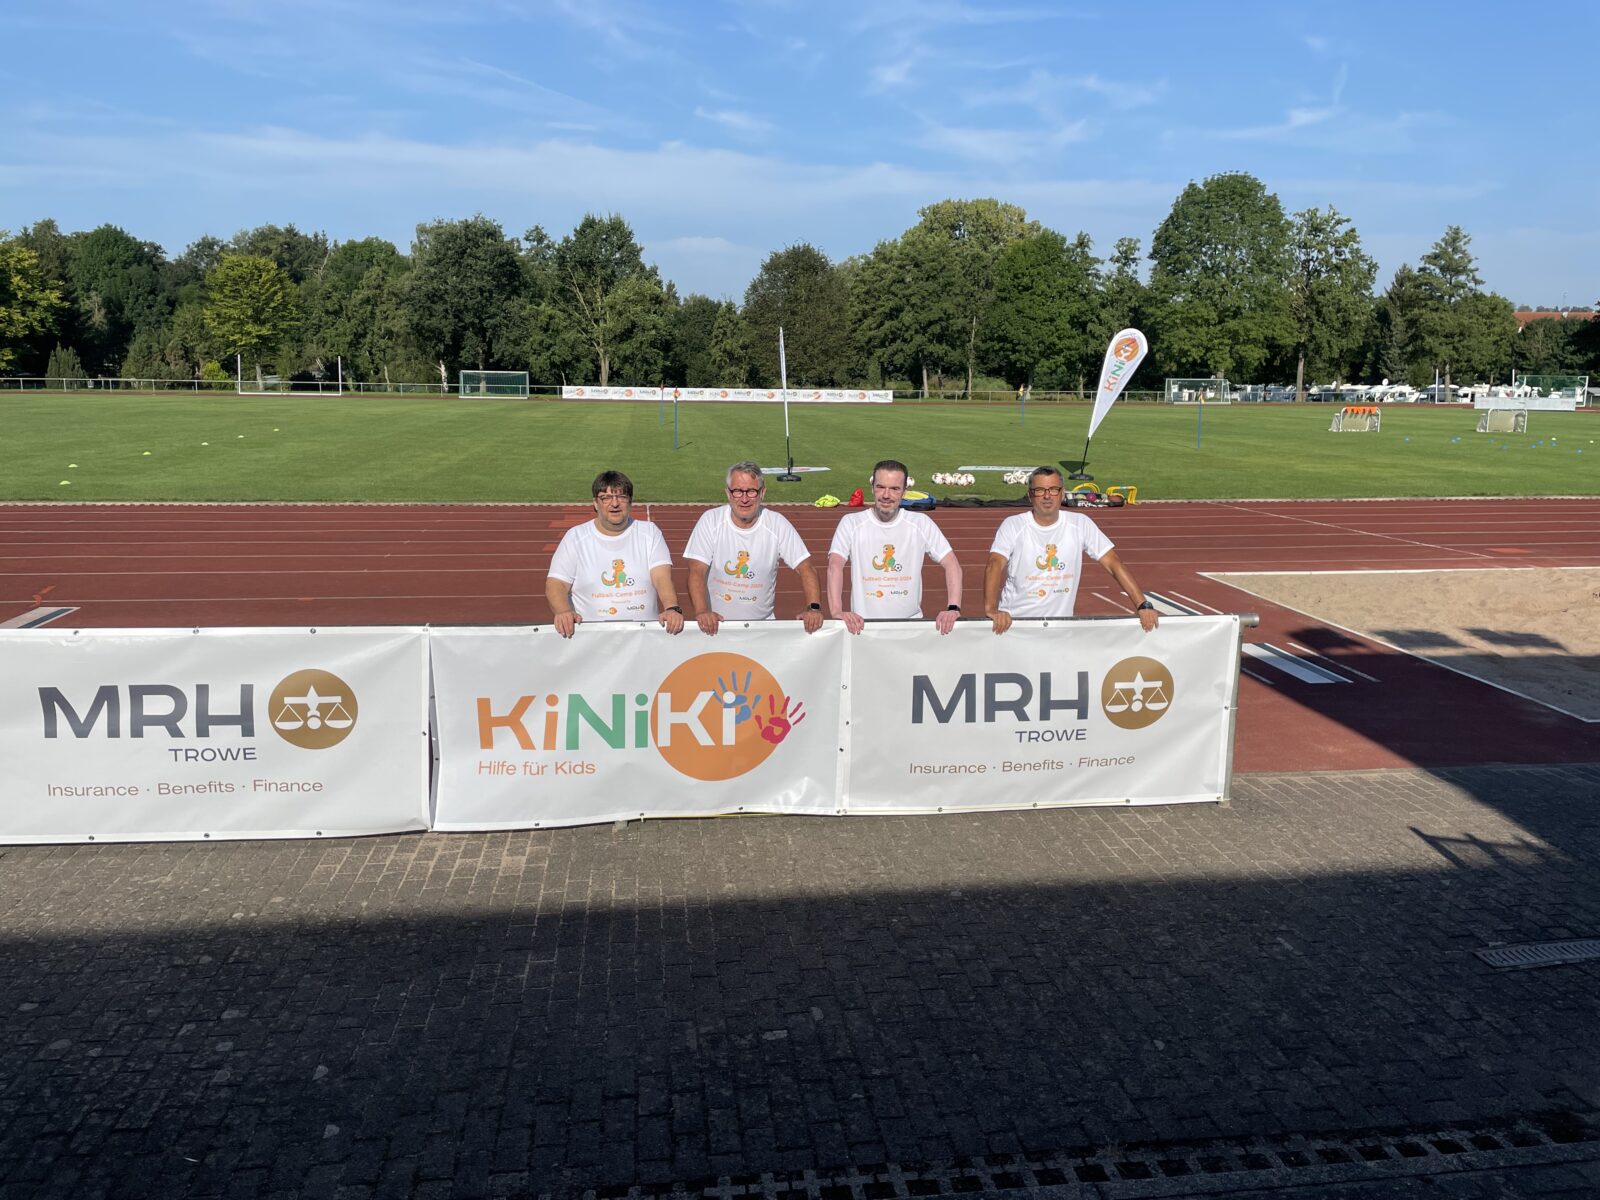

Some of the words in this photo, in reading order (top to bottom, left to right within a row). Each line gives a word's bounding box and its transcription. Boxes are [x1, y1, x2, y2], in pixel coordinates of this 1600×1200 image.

[912, 671, 1089, 724] MRH
[38, 684, 255, 738] MRH
[476, 691, 737, 751] KiNiKi
[1015, 728, 1087, 743] TROWE
[168, 747, 257, 762] TROWE
[909, 762, 987, 775] Insurance
[1001, 758, 1064, 773] Benefits
[1078, 754, 1136, 769] Finance
[478, 760, 517, 776] Hilfe
[522, 760, 548, 776] für
[555, 760, 596, 775] Kids
[47, 784, 139, 797] Insurance
[157, 780, 236, 795] Benefits
[252, 778, 324, 792] Finance
